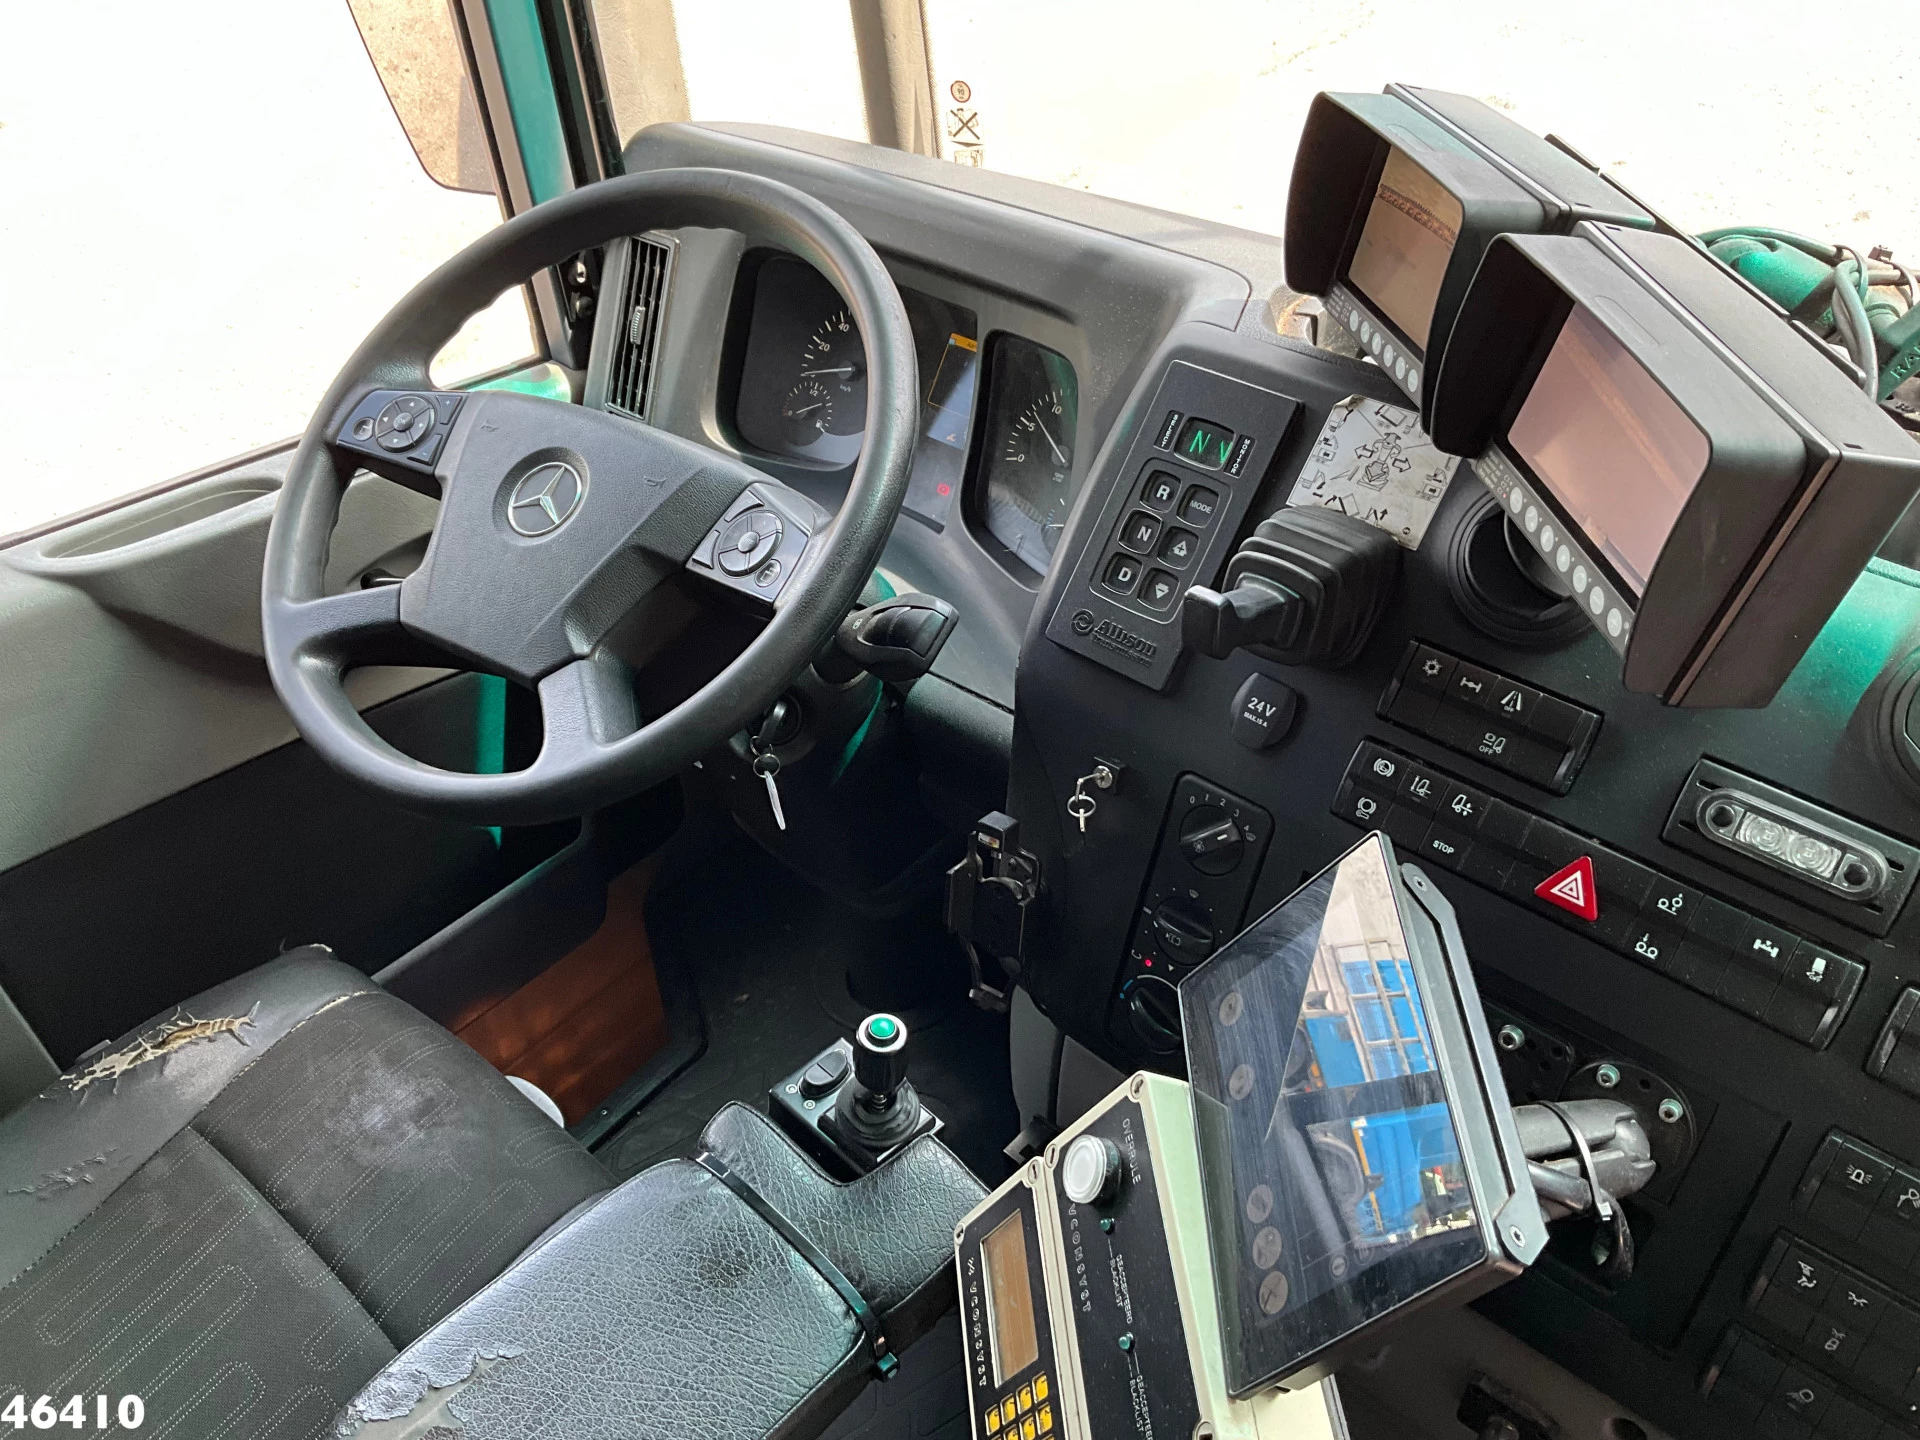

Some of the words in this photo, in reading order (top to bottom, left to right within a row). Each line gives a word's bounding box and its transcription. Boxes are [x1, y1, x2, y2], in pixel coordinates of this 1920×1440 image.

[838, 322, 849, 332] 40
[819, 342, 830, 352] 20
[1052, 404, 1062, 415] 10
[1028, 422, 1036, 431] 5
[1161, 414, 1179, 448] SELECT
[1017, 453, 1025, 462] 0
[1230, 438, 1251, 475] MONITOR
[1156, 484, 1171, 501] R
[1189, 500, 1213, 514] MODE
[1136, 525, 1152, 542] N
[1117, 566, 1132, 582] D
[1478, 745, 1494, 756] OFF
[1189, 795, 1196, 804] 0
[1219, 798, 1226, 807] 2
[1233, 808, 1240, 817] 3
[1432, 839, 1455, 854] STOP
[1121, 1117, 1142, 1186] OVERRULE
[1109, 1258, 1124, 1307] BLACKLIST
[1129, 1378, 1145, 1432] BLACKLIST
